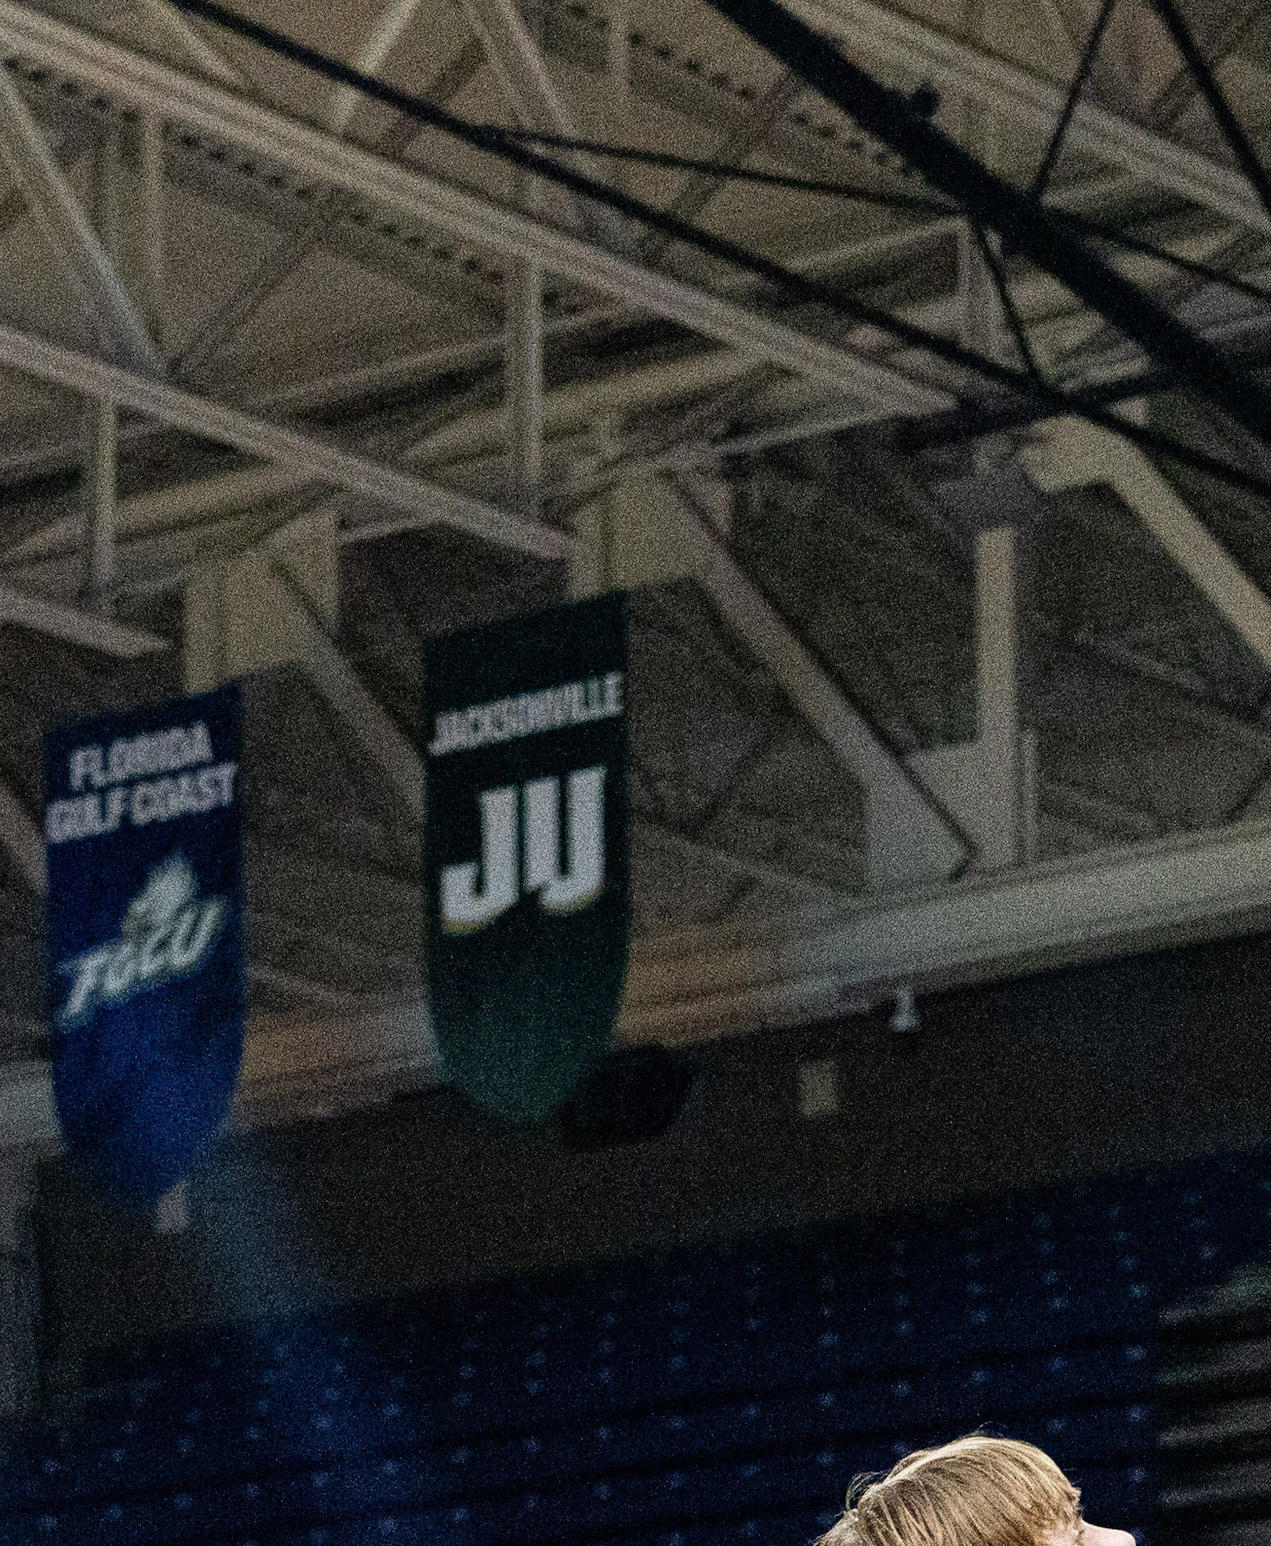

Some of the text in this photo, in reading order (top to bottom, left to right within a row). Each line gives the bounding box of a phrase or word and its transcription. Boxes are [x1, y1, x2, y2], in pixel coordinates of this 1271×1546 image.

[69, 719, 214, 791] FLORIDA
[428, 671, 625, 757] JACKSONVILLE
[46, 760, 238, 846] GULF COAST
[441, 765, 607, 933] JU
